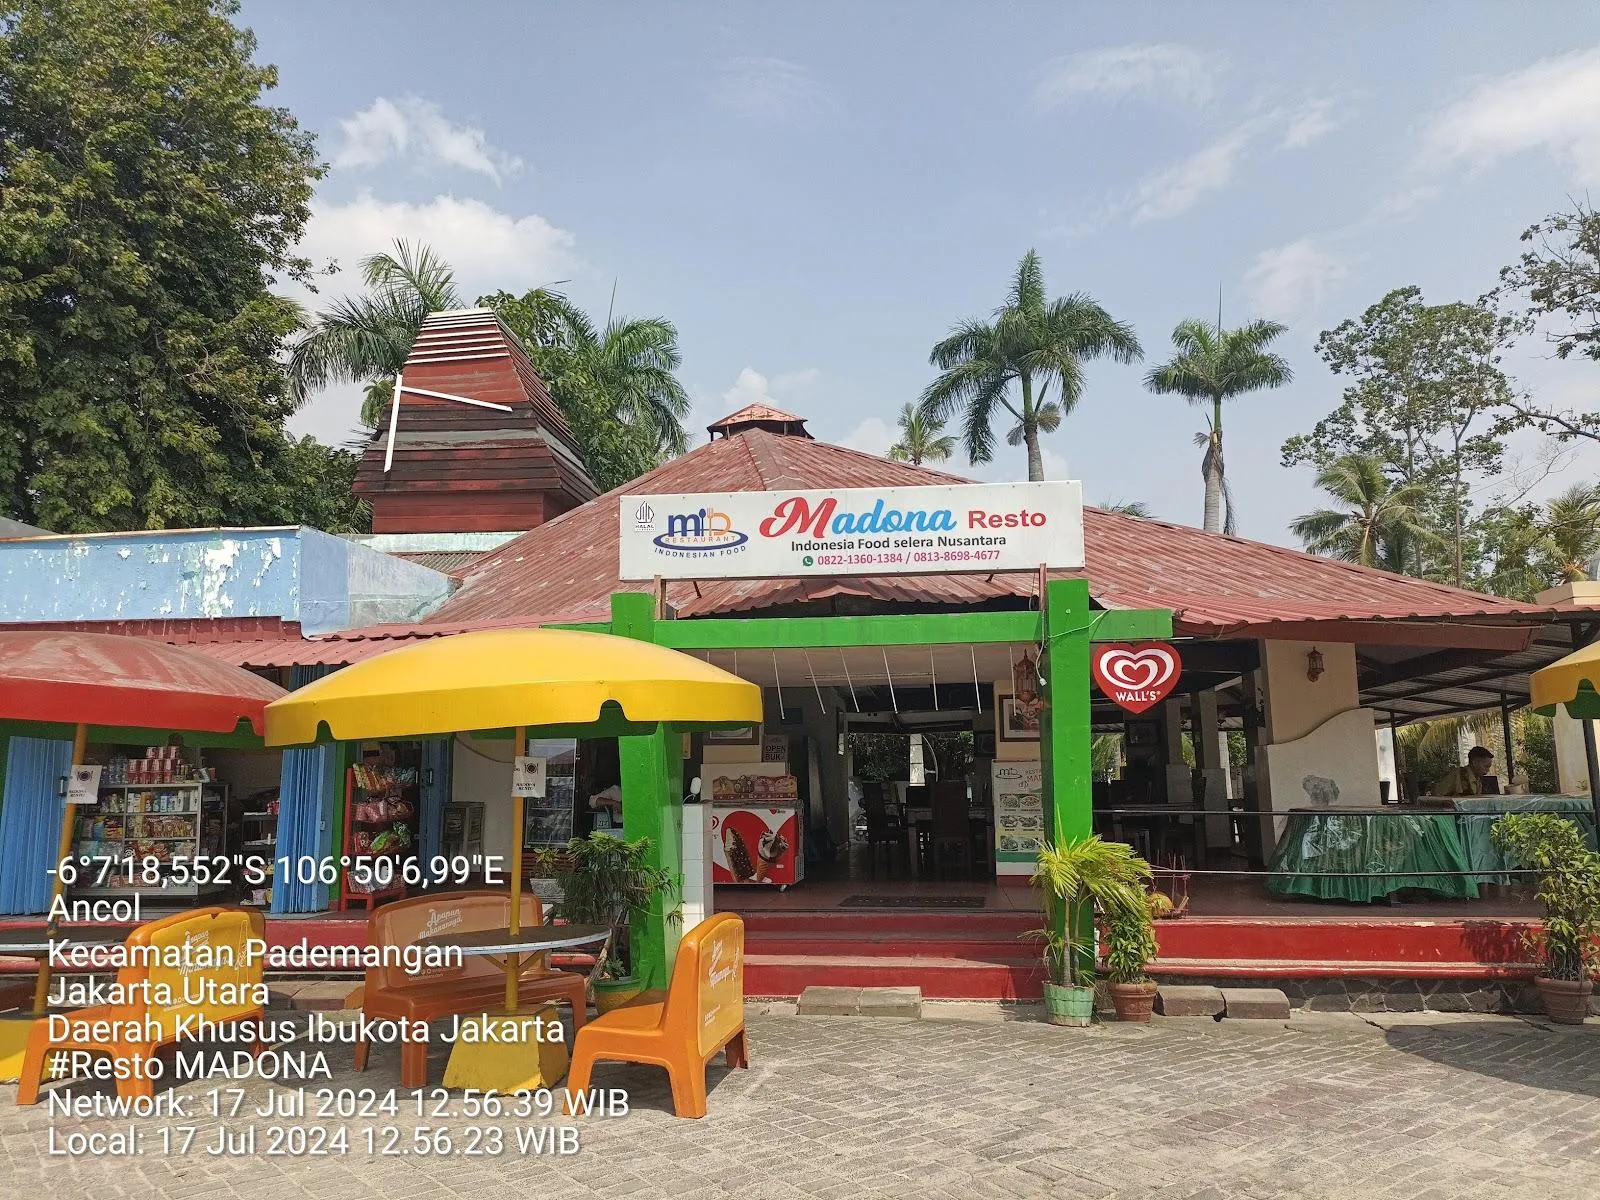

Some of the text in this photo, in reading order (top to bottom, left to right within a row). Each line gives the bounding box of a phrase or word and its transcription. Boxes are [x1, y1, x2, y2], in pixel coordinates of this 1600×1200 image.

[758, 496, 1047, 539] Madona Resto
[664, 535, 736, 544] RESTAURANT
[791, 535, 1007, 552] Indonesia Food selera Nusantara
[654, 545, 747, 559] INDONESIAN FOOD
[816, 553, 904, 566] 0822-1360-1384
[913, 550, 1001, 563] 0813-8698-4677
[1115, 690, 1157, 702] WALL'S
